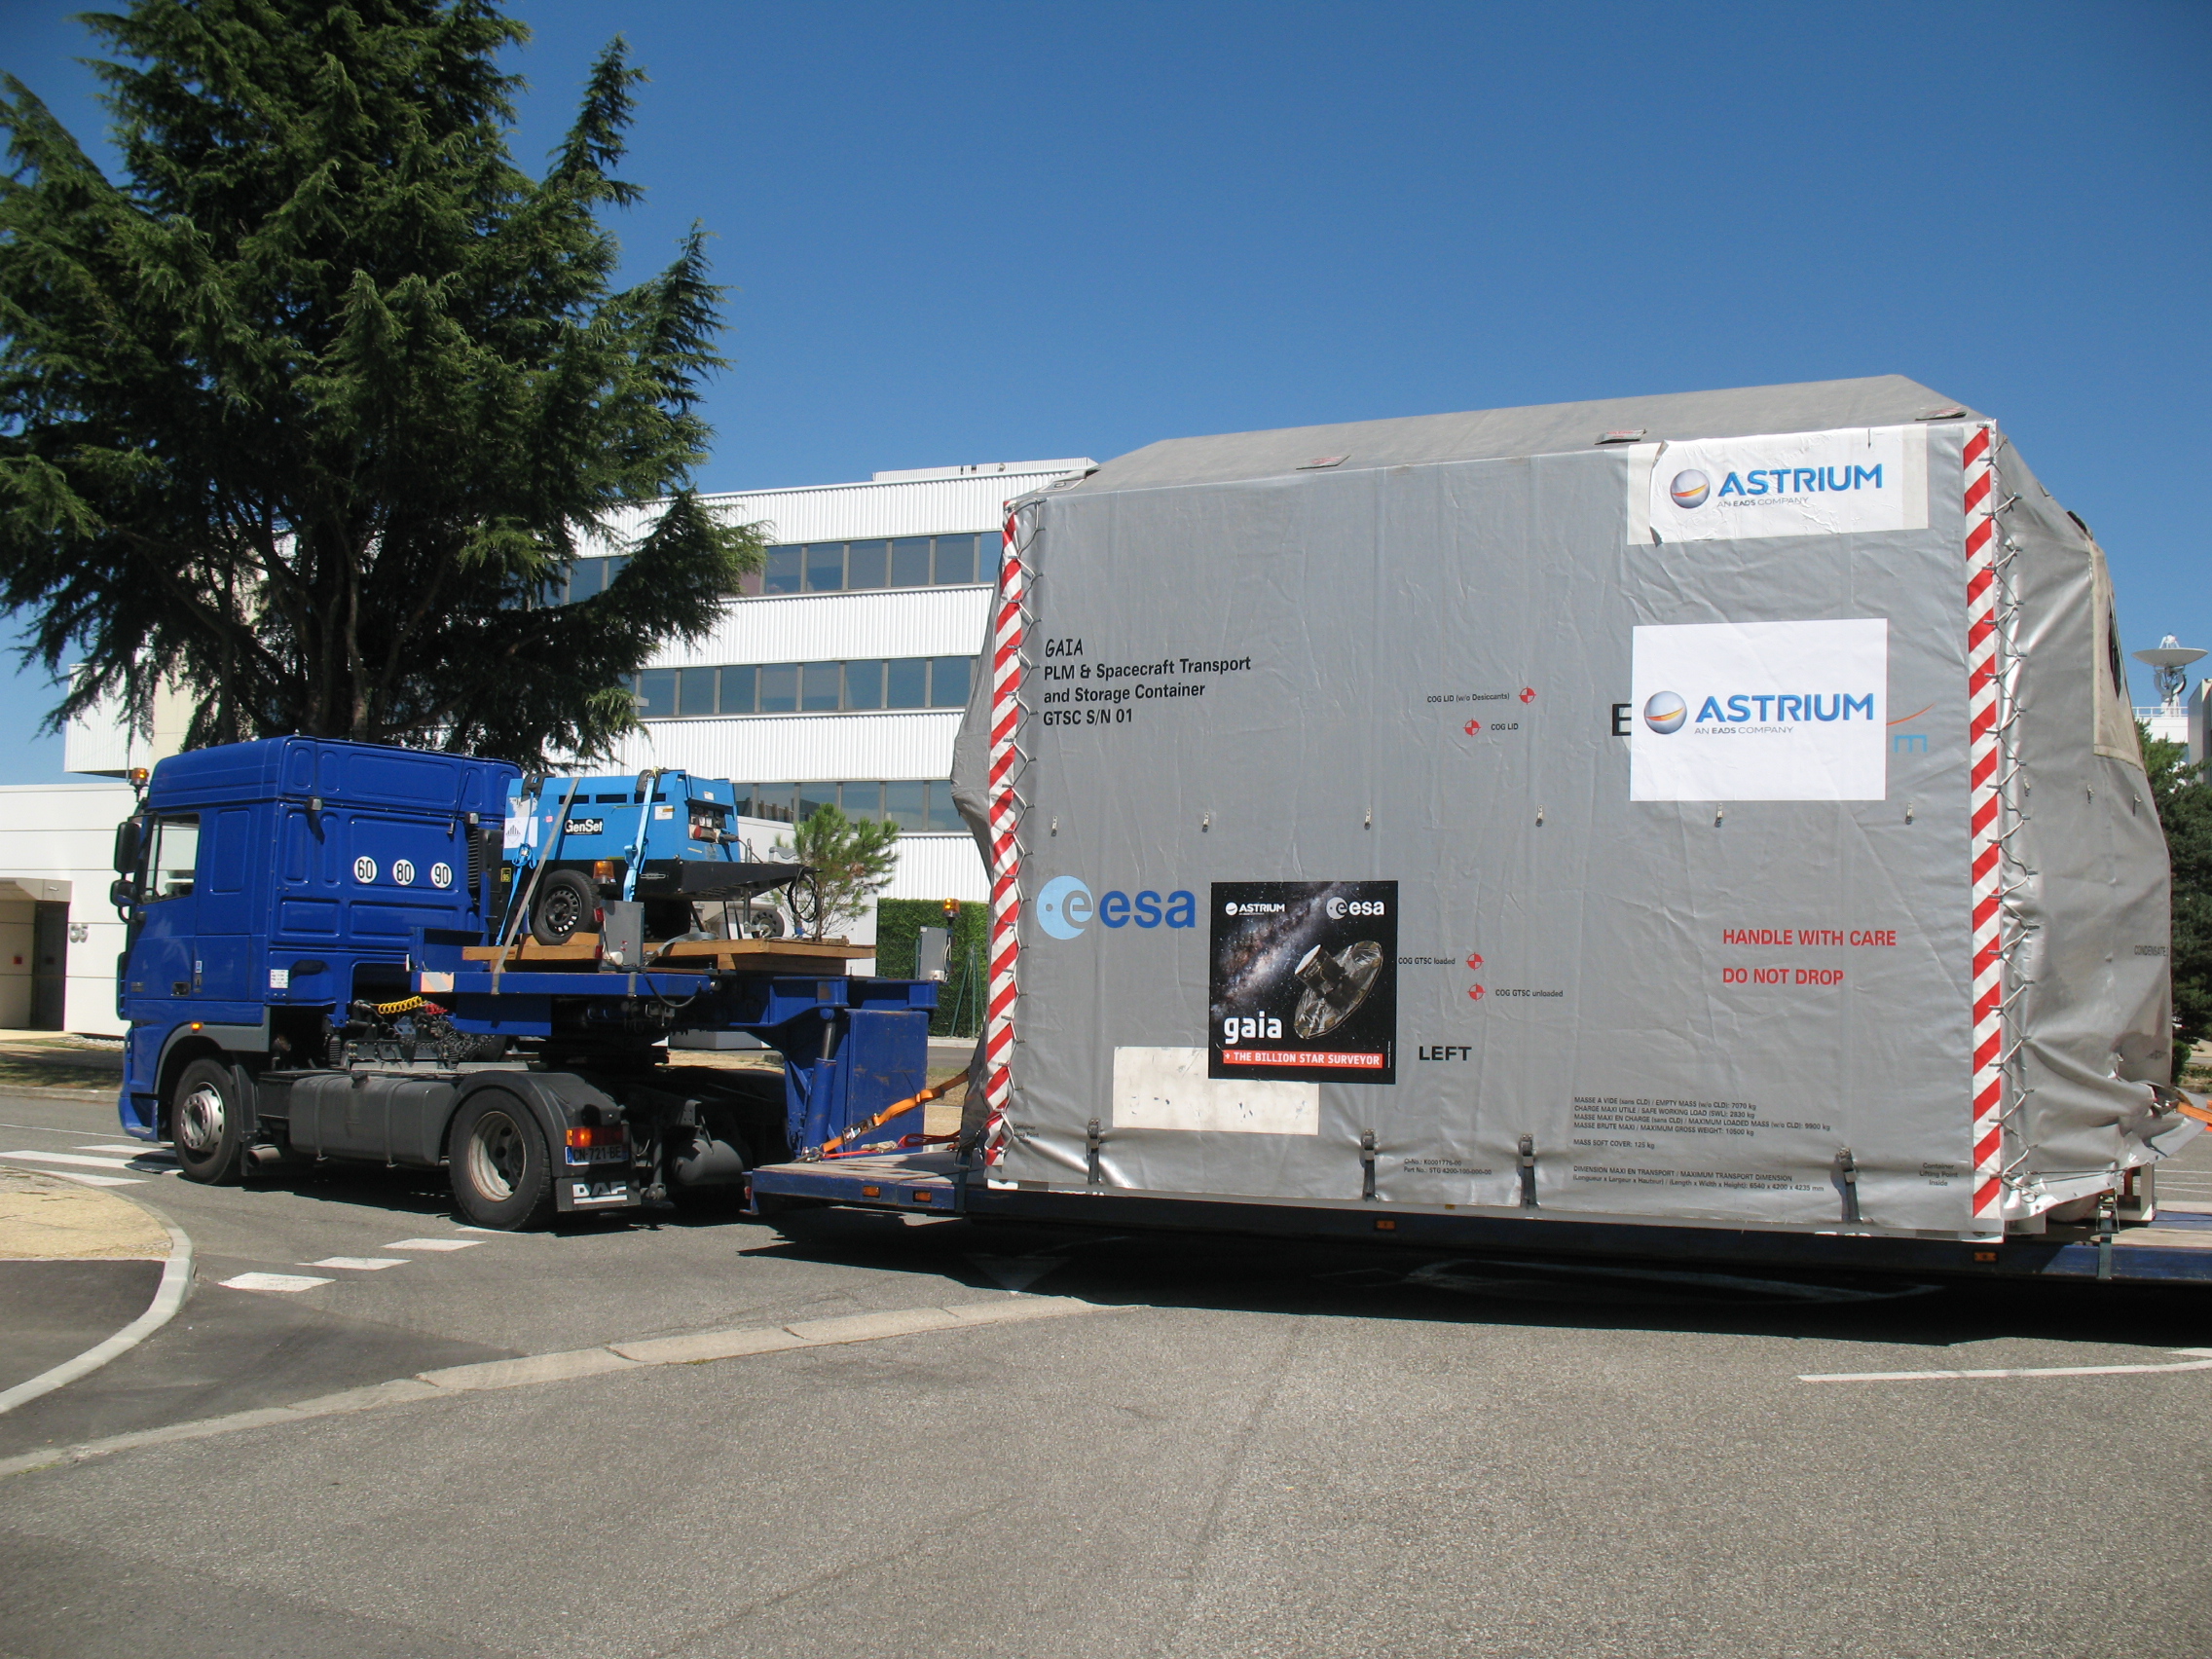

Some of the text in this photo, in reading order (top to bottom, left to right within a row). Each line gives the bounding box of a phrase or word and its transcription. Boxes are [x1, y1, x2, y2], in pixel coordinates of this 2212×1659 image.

[1717, 463, 1882, 497] ASTRIUM
[1757, 497, 1809, 506] COMPANY
[1046, 639, 1083, 657] GAIA
[1045, 656, 1251, 682] PLM & Spacecraft Transport
[1044, 682, 1205, 703] and Storage Container
[1695, 693, 1873, 723] ASTRIUM
[1044, 709, 1131, 725] GTSC S/N 01
[566, 819, 603, 832] GenSet
[357, 860, 373, 879] 60
[396, 863, 411, 882] 80
[434, 866, 449, 884] 90
[1099, 890, 1196, 929] esa
[1238, 903, 1285, 912] ASTRIUM
[1349, 902, 1384, 915] esa
[1723, 929, 1897, 946] HANDLE WITH CARE
[1723, 968, 1844, 985] DO NOT DROP
[1224, 1011, 1282, 1045] gaia
[1234, 1051, 1380, 1065] THE BILLION STAR SURVEYOR
[1419, 1046, 1472, 1061] LEFT
[573, 1147, 621, 1161] CN-721-BE
[572, 1181, 627, 1198] DAF
